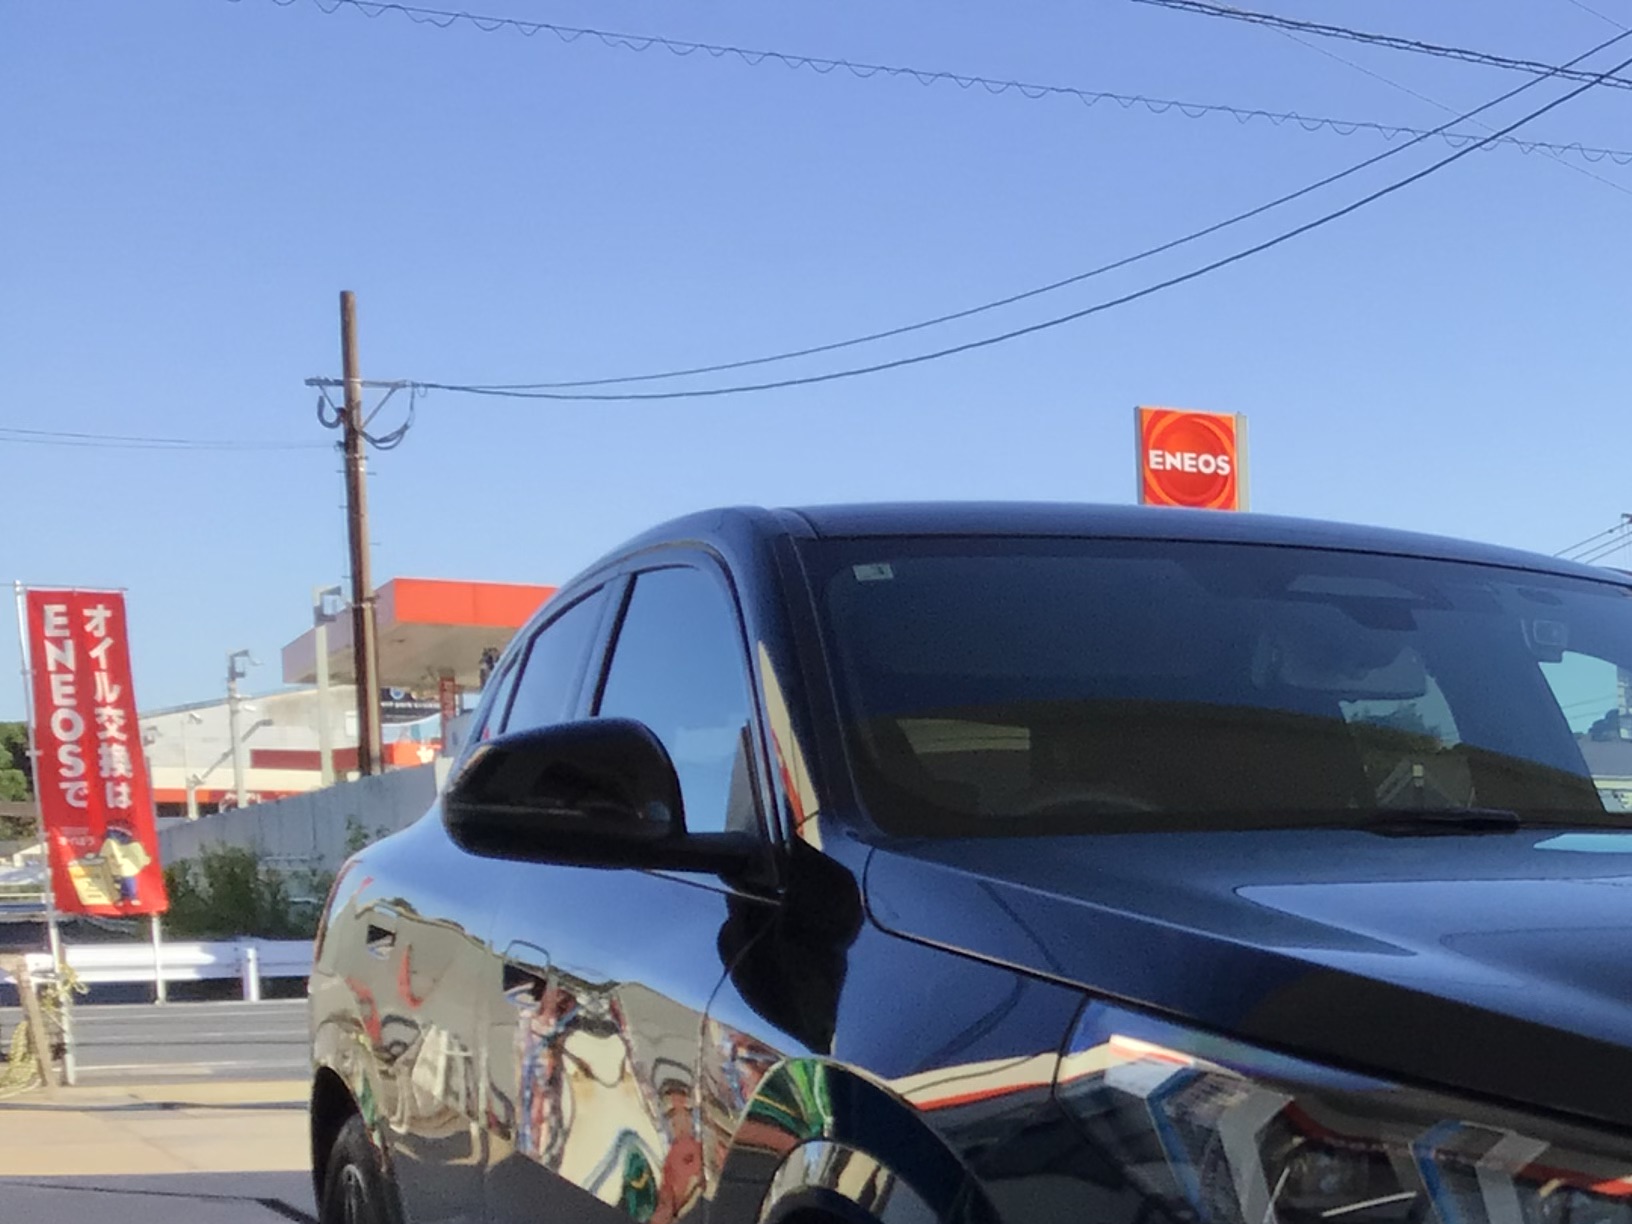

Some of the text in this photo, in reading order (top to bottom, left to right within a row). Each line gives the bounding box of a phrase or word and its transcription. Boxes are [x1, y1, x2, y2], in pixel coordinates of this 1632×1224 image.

[1149, 449, 1231, 476] ENEOS
[42, 603, 90, 809] ENEOSで
[82, 603, 133, 811] オイル交換は
